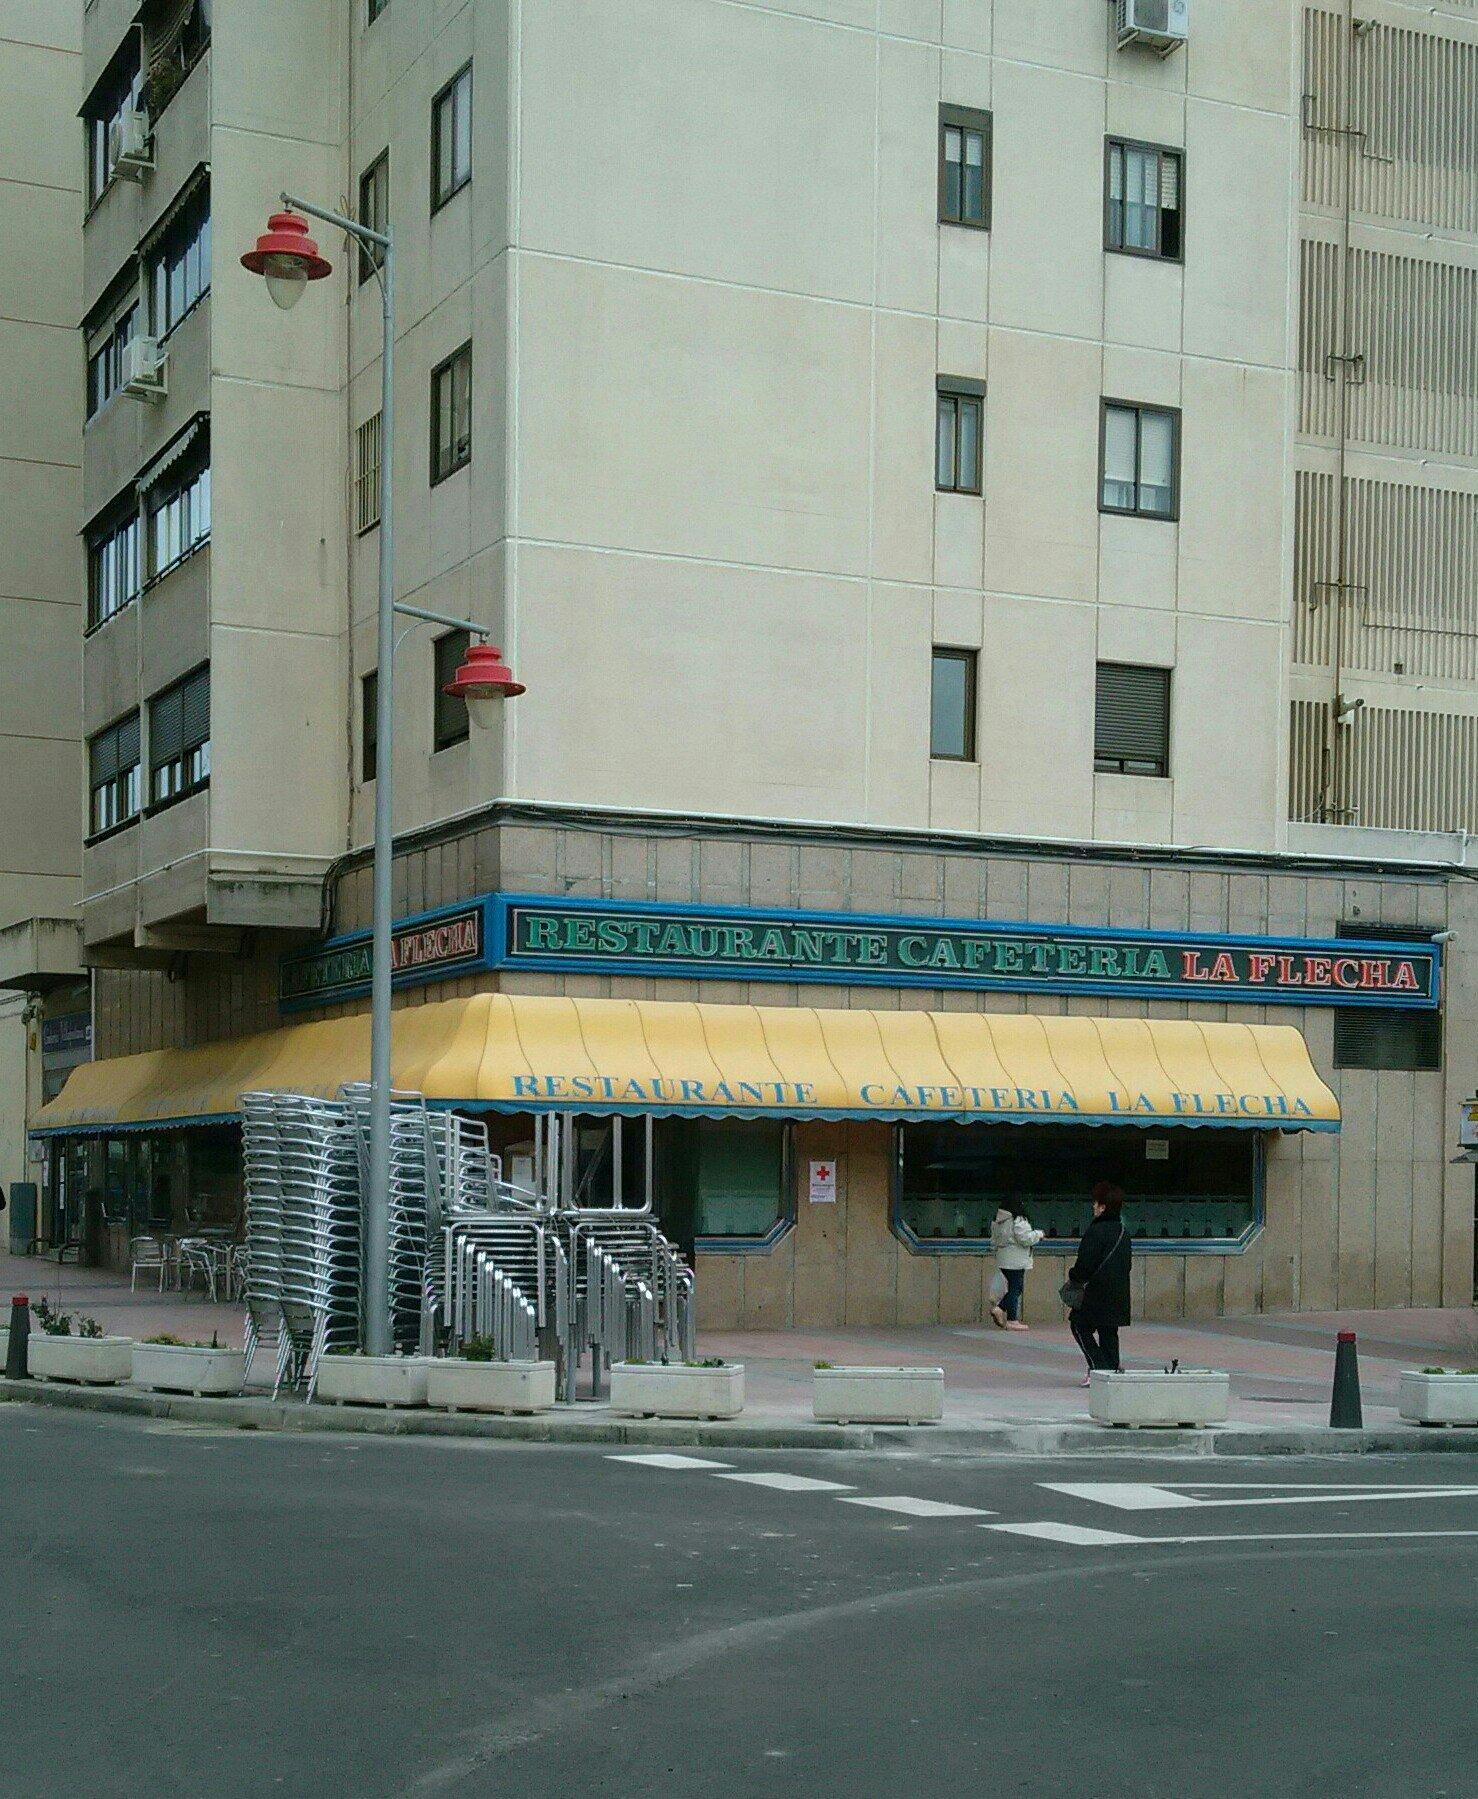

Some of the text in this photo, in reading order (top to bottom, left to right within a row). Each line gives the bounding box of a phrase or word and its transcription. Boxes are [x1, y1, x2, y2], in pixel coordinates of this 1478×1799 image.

[401, 920, 476, 968] FLECHA
[525, 915, 1420, 990] RESTAURANTE CAFETERIA LA FLECHA
[511, 1074, 1314, 1116] RESTAURANTE CAFETERIA LA FLECHA
